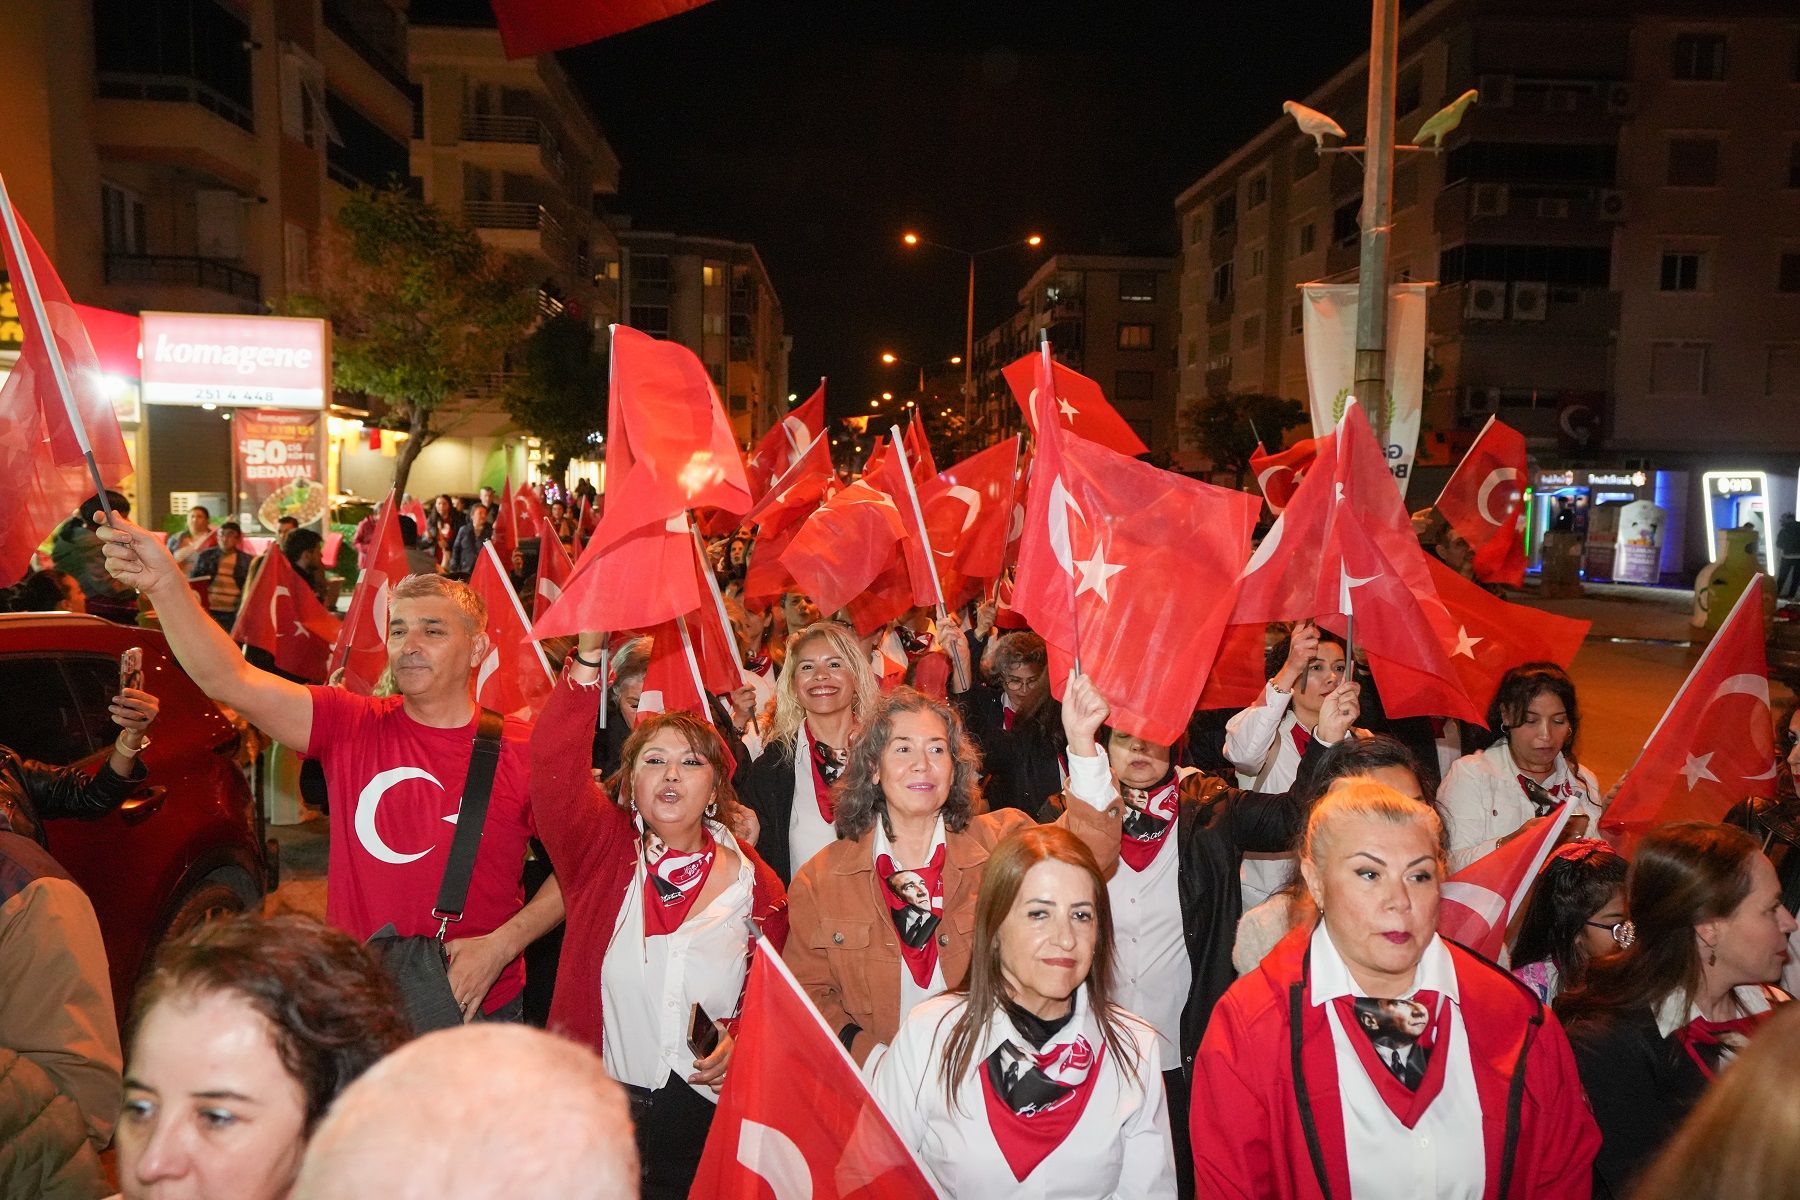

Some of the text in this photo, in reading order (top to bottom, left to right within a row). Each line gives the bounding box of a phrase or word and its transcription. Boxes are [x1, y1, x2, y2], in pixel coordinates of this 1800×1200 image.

[154, 333, 313, 374] komagene
[245, 439, 288, 465] 50
[246, 464, 312, 479] BEDAVA!
